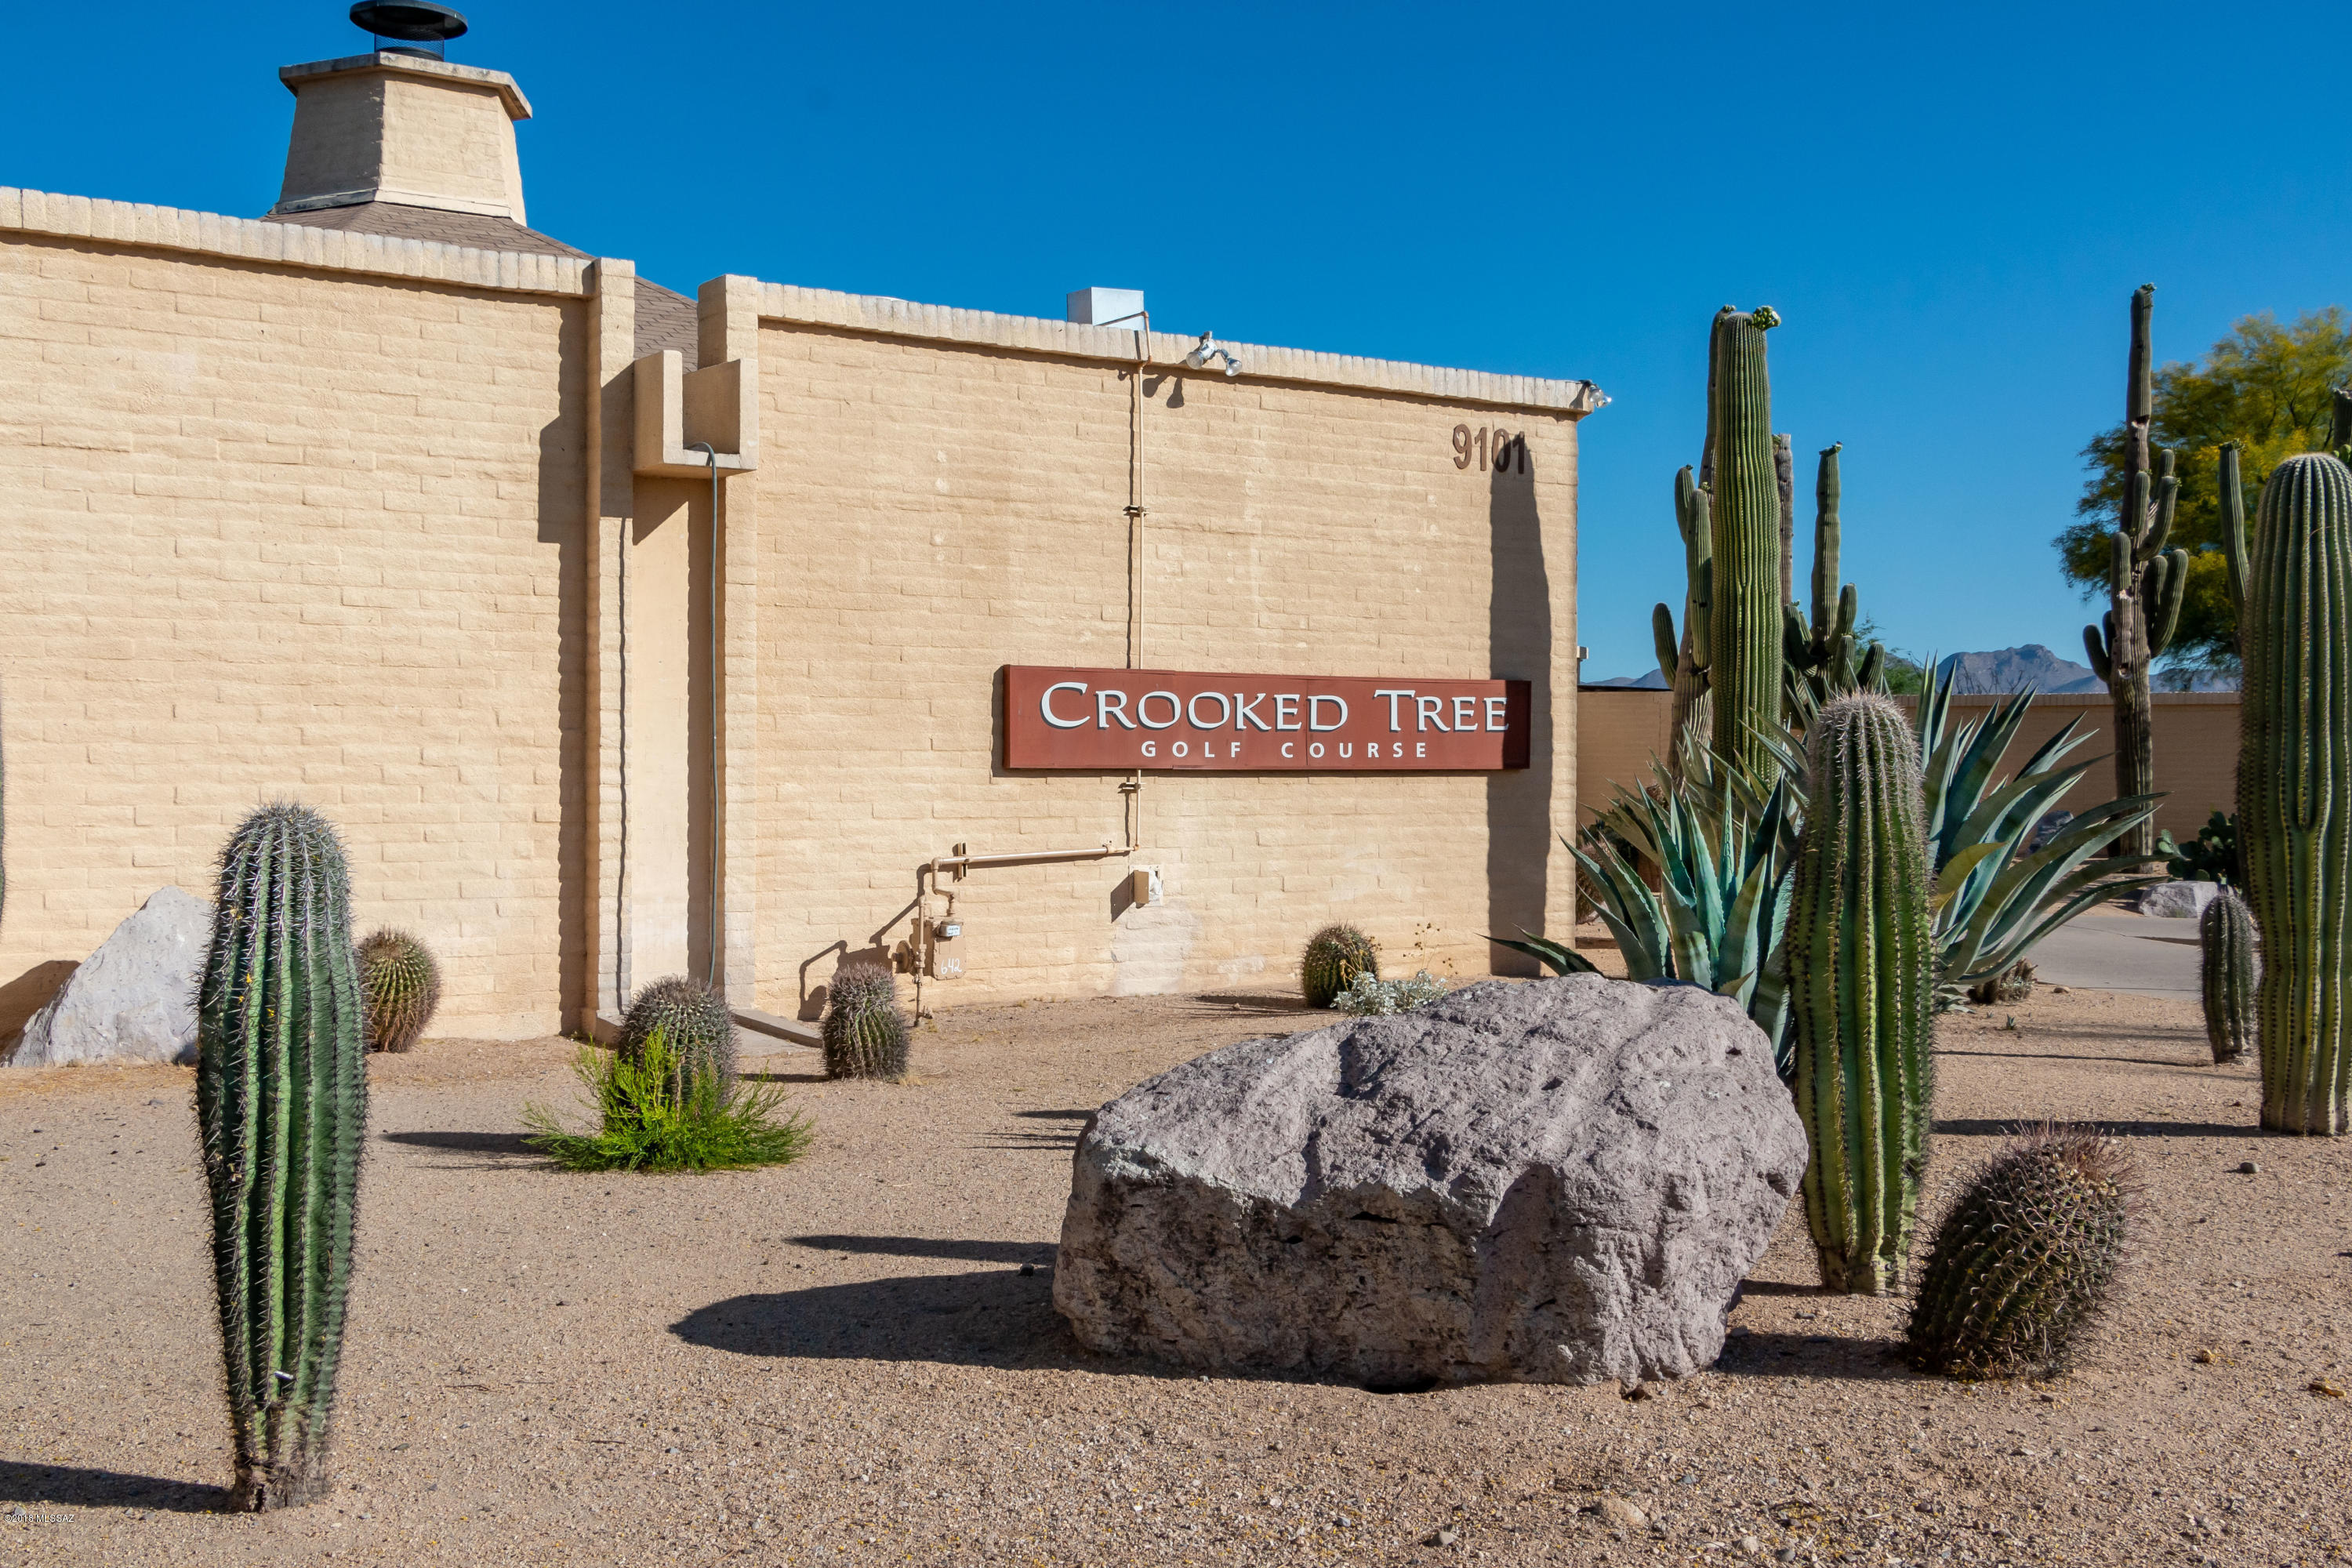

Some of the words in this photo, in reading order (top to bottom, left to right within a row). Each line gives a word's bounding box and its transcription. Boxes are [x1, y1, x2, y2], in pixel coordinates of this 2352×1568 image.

[1453, 424, 1525, 474] 9101
[1040, 681, 1348, 732] CROOKED
[1373, 689, 1509, 733] TREE
[1141, 741, 1241, 758] GOLF
[1281, 742, 1427, 758] COURSE
[941, 958, 962, 975] 642
